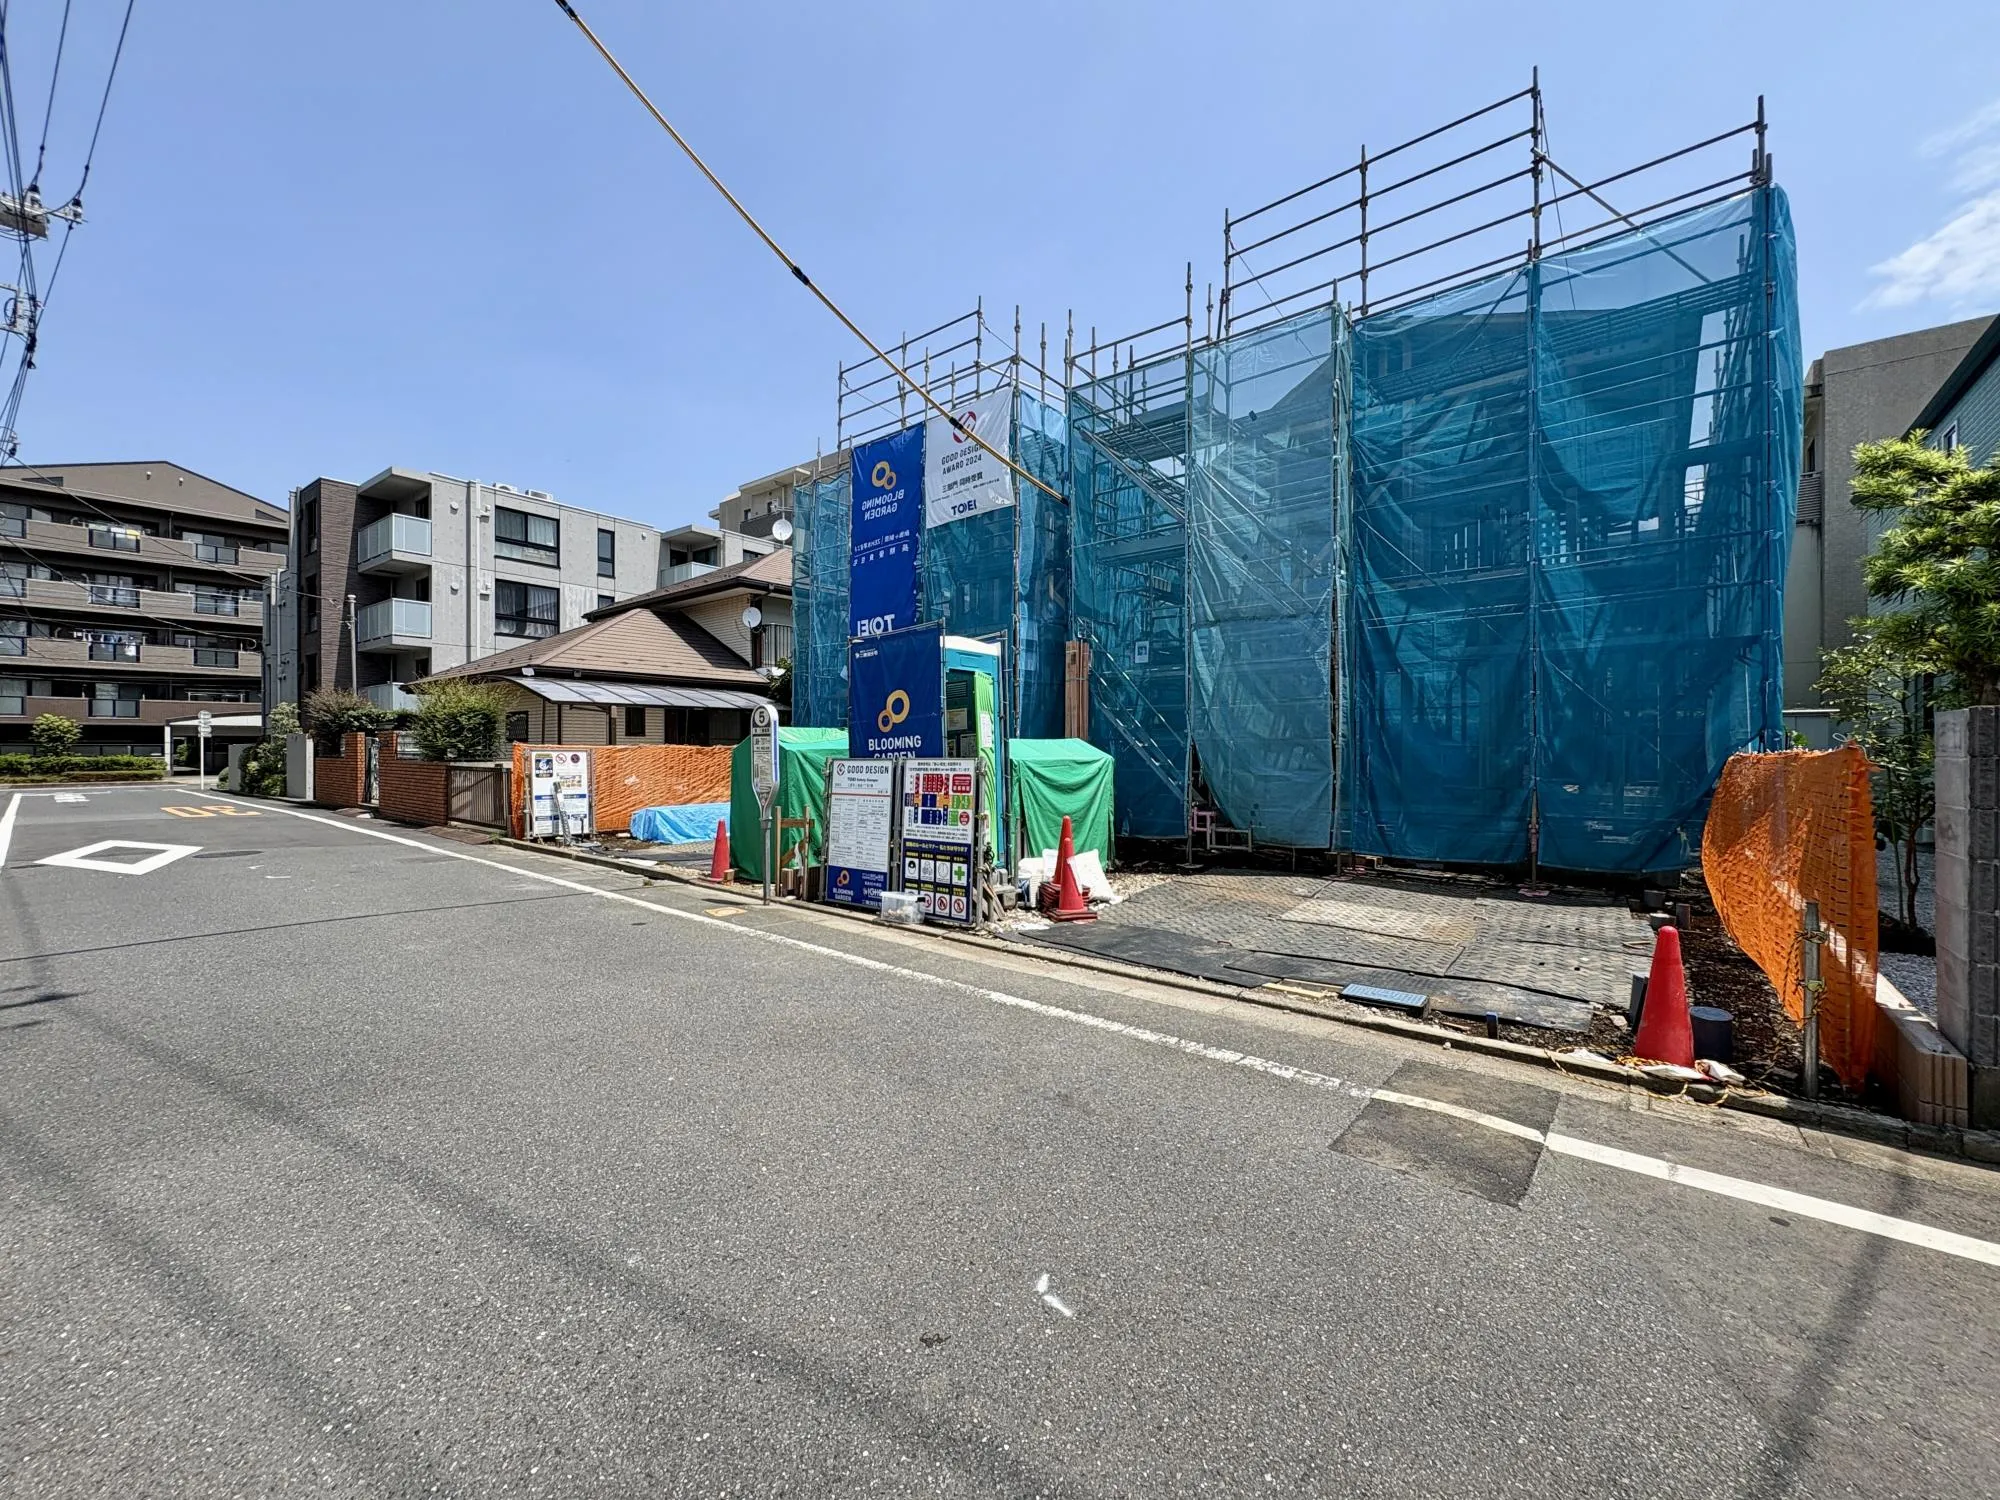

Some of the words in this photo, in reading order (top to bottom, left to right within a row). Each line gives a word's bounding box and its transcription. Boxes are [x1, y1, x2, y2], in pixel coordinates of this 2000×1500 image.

[941, 451, 959, 465] GOOD
[960, 442, 983, 458] DESIG
[942, 460, 964, 475] AWARD
[965, 453, 982, 467] 2024
[759, 711, 765, 724] 5
[868, 735, 921, 750] BLOOMING
[847, 765, 864, 774] GOOD
[865, 765, 889, 775] DESIGN
